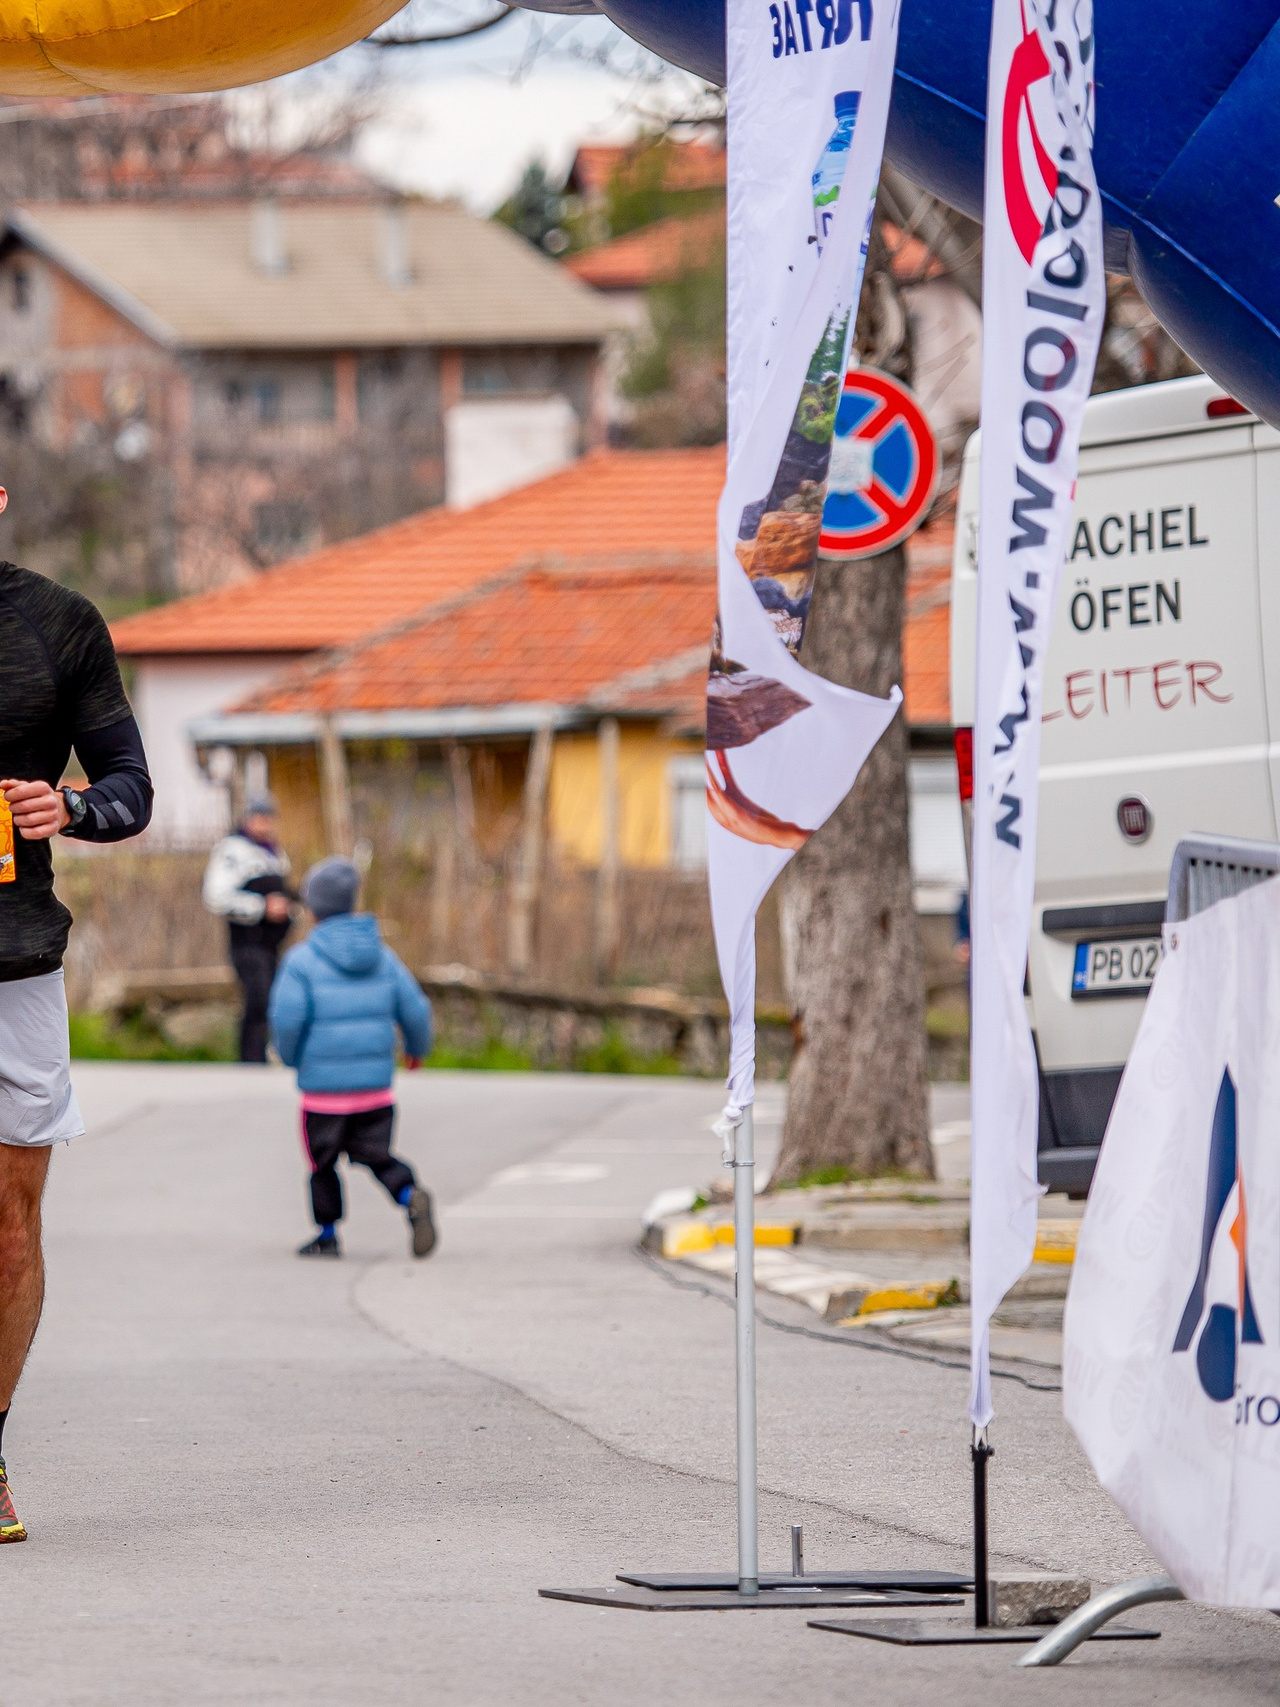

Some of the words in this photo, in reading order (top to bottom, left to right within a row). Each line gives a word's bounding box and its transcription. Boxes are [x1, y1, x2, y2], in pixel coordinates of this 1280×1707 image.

[1065, 504, 1210, 562] ACHEL
[1070, 578, 1182, 632] ÖFEN
[1092, 947, 1123, 981] PB
[1130, 941, 1166, 979] 02
